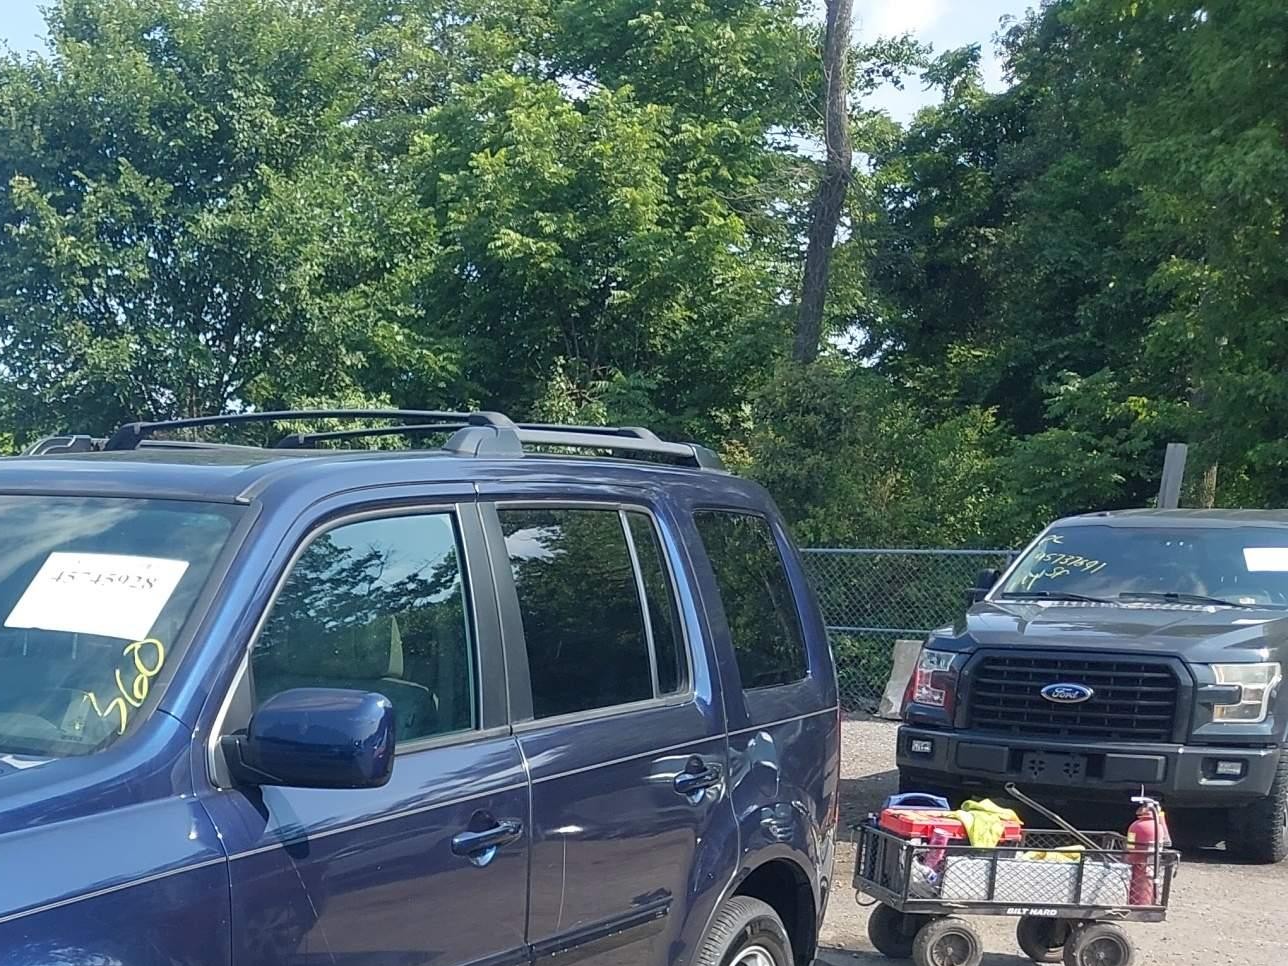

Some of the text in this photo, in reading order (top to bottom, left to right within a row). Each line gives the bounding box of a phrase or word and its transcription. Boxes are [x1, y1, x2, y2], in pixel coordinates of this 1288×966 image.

[83, 638, 164, 735] 360
[1052, 687, 1080, 699] Ford
[1006, 907, 1058, 916] BILT HARD
